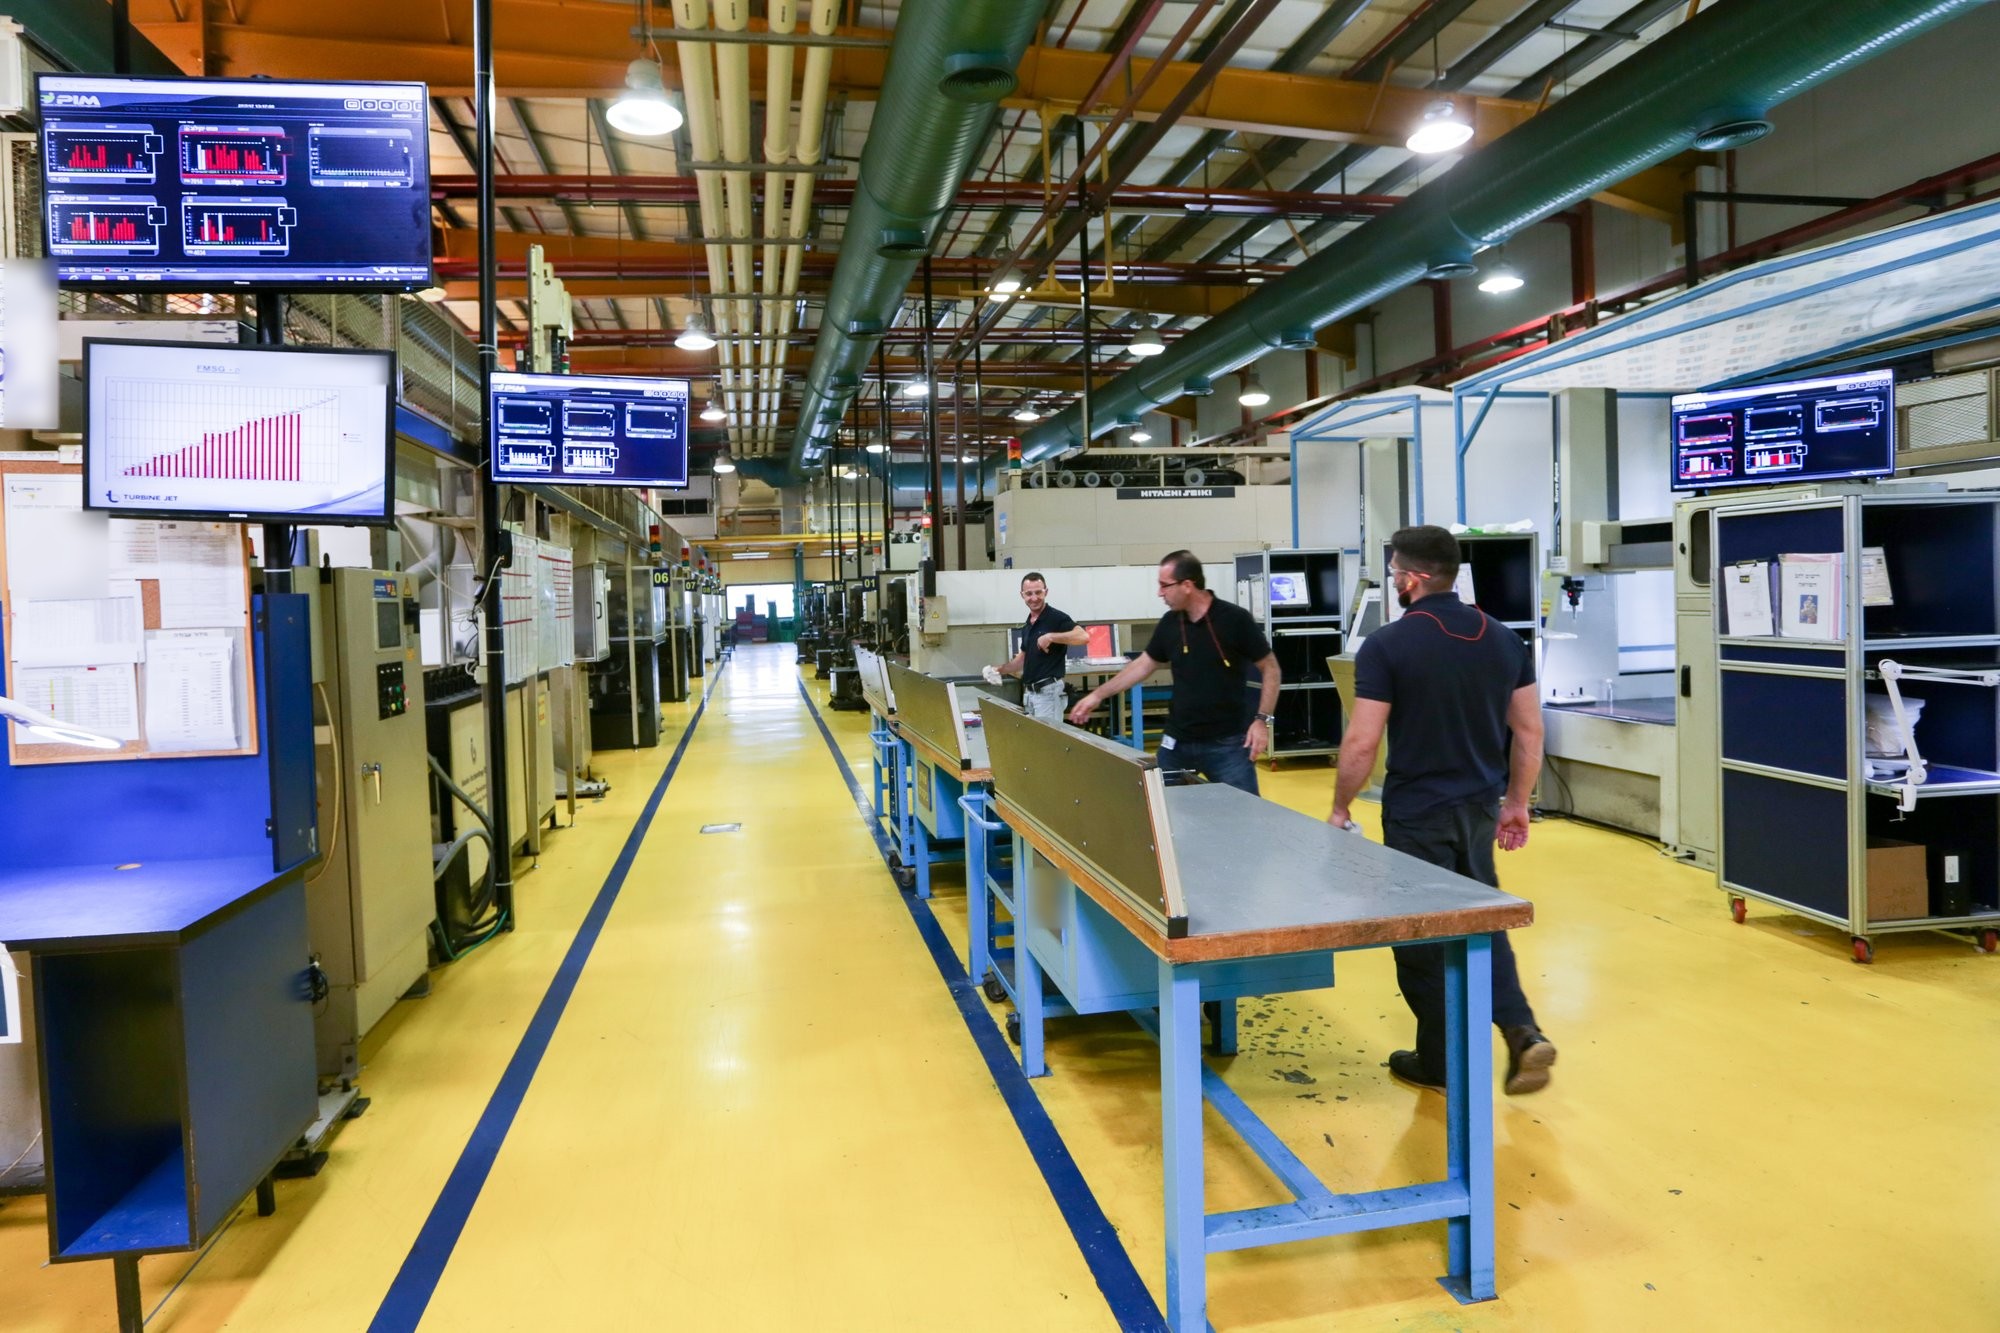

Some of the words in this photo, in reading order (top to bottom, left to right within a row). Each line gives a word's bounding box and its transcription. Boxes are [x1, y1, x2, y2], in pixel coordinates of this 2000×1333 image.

[56, 95, 101, 106] PIM
[1140, 489, 1182, 497] HITACHI
[1183, 489, 1213, 497] SEIKI
[654, 572, 669, 584] 06
[864, 578, 876, 588] 01
[685, 581, 696, 590] 07
